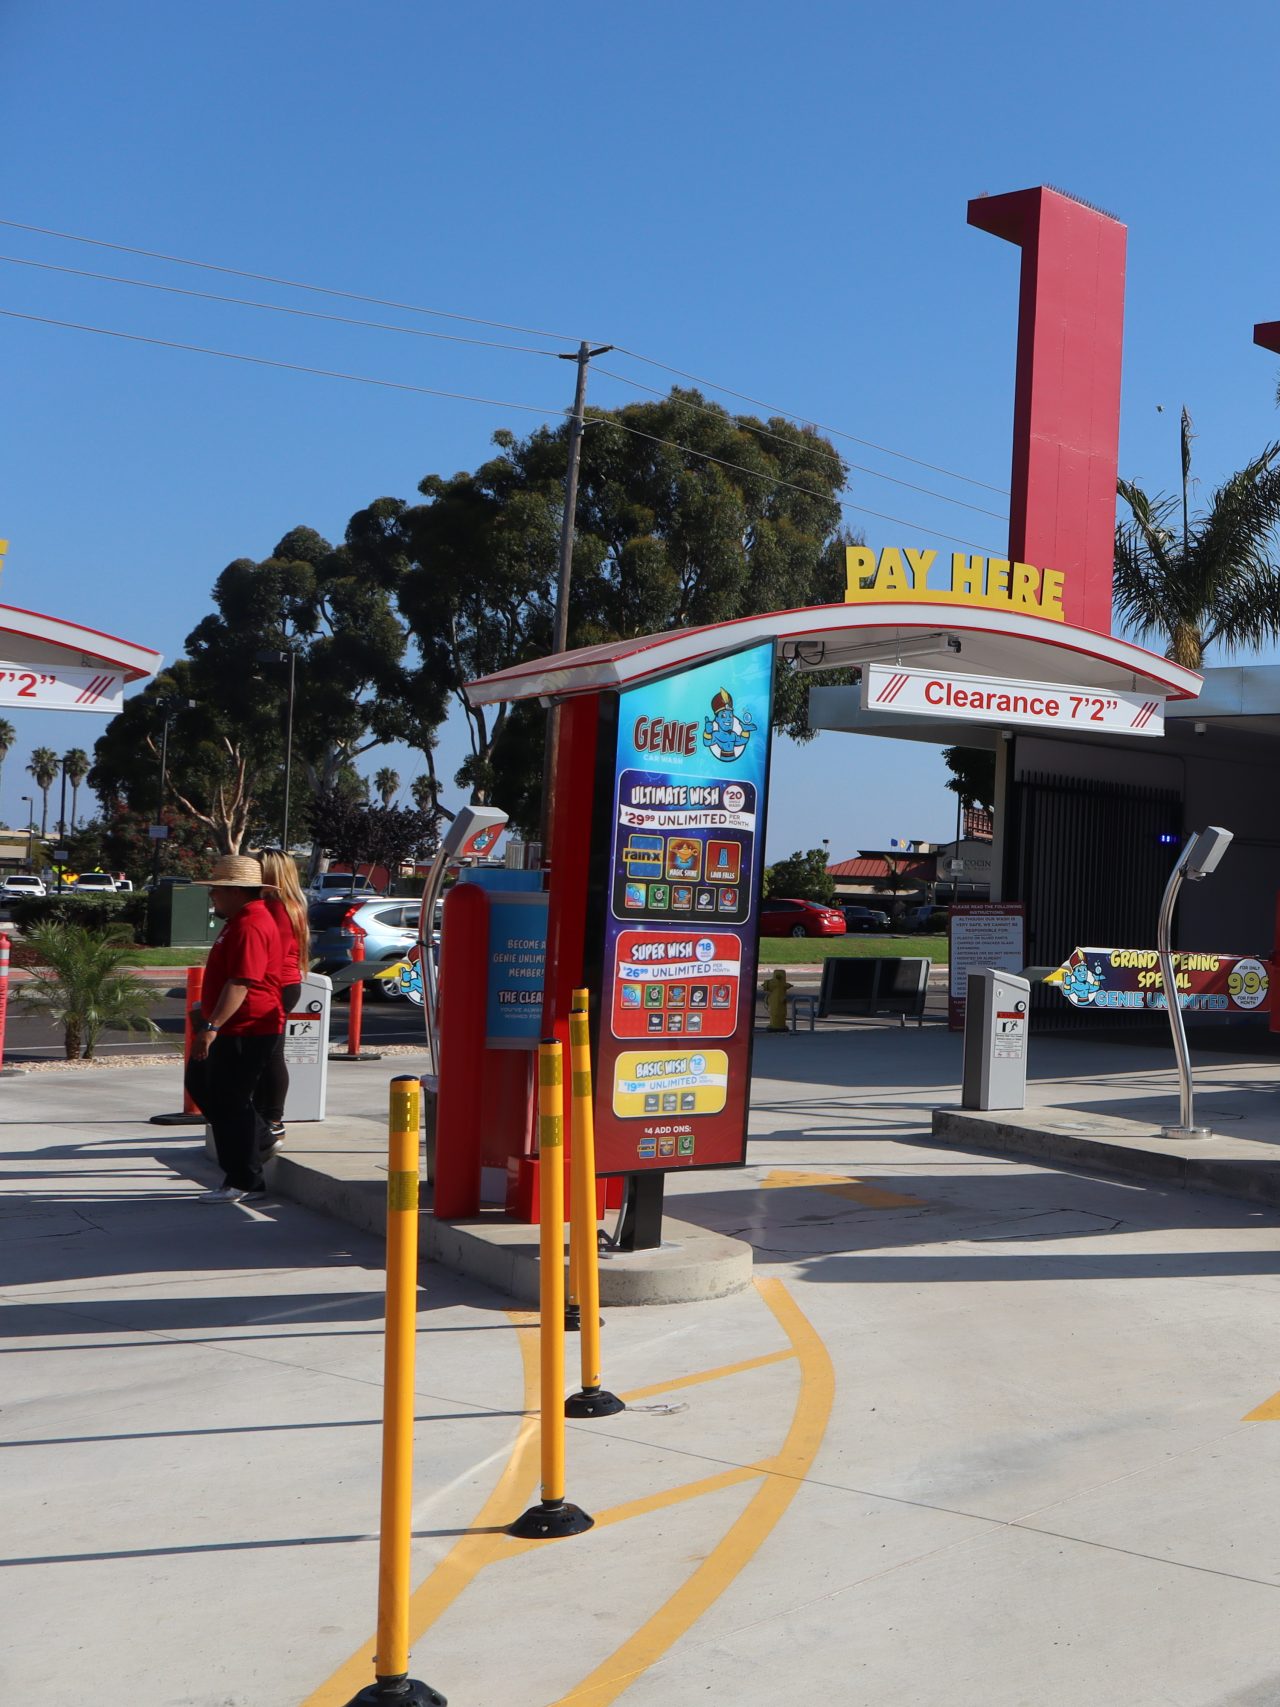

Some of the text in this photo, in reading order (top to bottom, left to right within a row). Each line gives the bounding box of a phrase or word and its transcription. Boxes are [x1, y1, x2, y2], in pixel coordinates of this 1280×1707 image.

[845, 546, 1065, 607] PAY HERE
[0, 672, 56, 697] ’2”
[924, 681, 1060, 717] Clearance
[634, 715, 699, 757] GENIE
[631, 785, 719, 806] ULTIMATE WISH
[658, 814, 726, 827] UNLIMITED
[507, 939, 539, 949] BECOME
[631, 941, 693, 960] SUPER WISH
[493, 953, 517, 963] GENIE
[1110, 950, 1219, 972] GRAND PENING
[652, 964, 711, 977] UNLIMITED
[1137, 971, 1191, 989] SPEAL
[498, 991, 517, 1003] THE
[1095, 990, 1229, 1010] GENIE UNIMITED
[636, 1058, 687, 1078] BASIC WISH
[650, 1077, 697, 1090] UNLIMITED
[655, 1126, 671, 1134] ADD
[673, 1125, 692, 1133] ONS:
